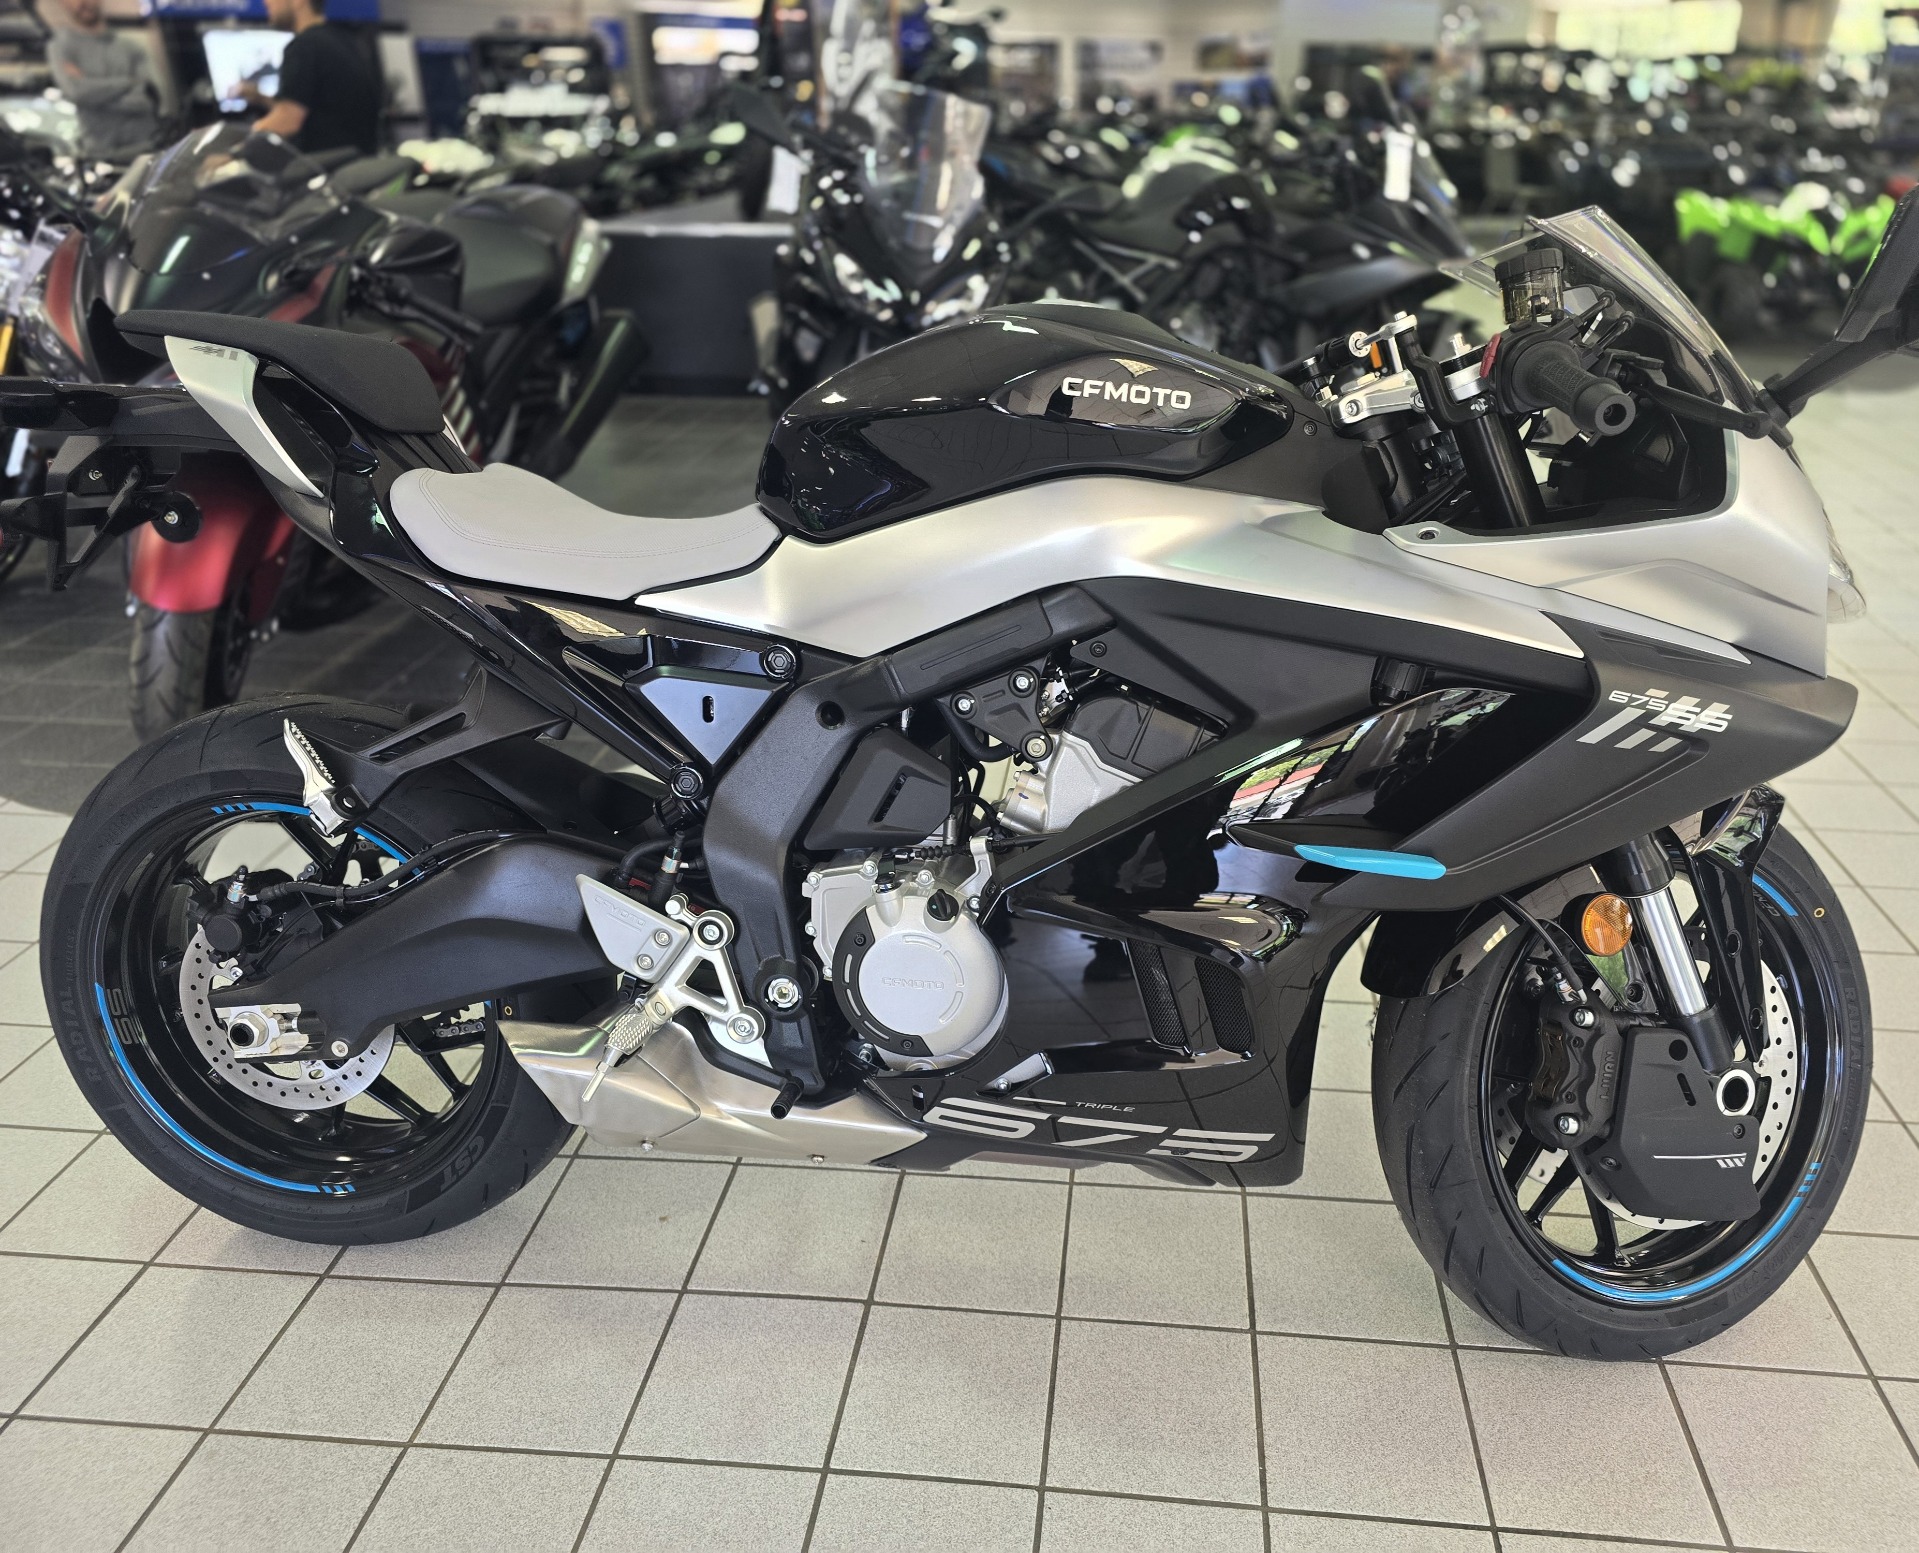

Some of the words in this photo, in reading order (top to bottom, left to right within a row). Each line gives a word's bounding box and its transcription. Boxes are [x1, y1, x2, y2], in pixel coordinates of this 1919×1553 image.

[1062, 377, 1192, 410] CFMOTO
[881, 976, 945, 991] CFMOTO
[107, 988, 140, 1045] SS
[1845, 987, 1862, 1072] RADIAL
[923, 1097, 1276, 1163] 675
[1075, 1100, 1136, 1114] TRIPLE
[440, 1135, 485, 1193] CST
